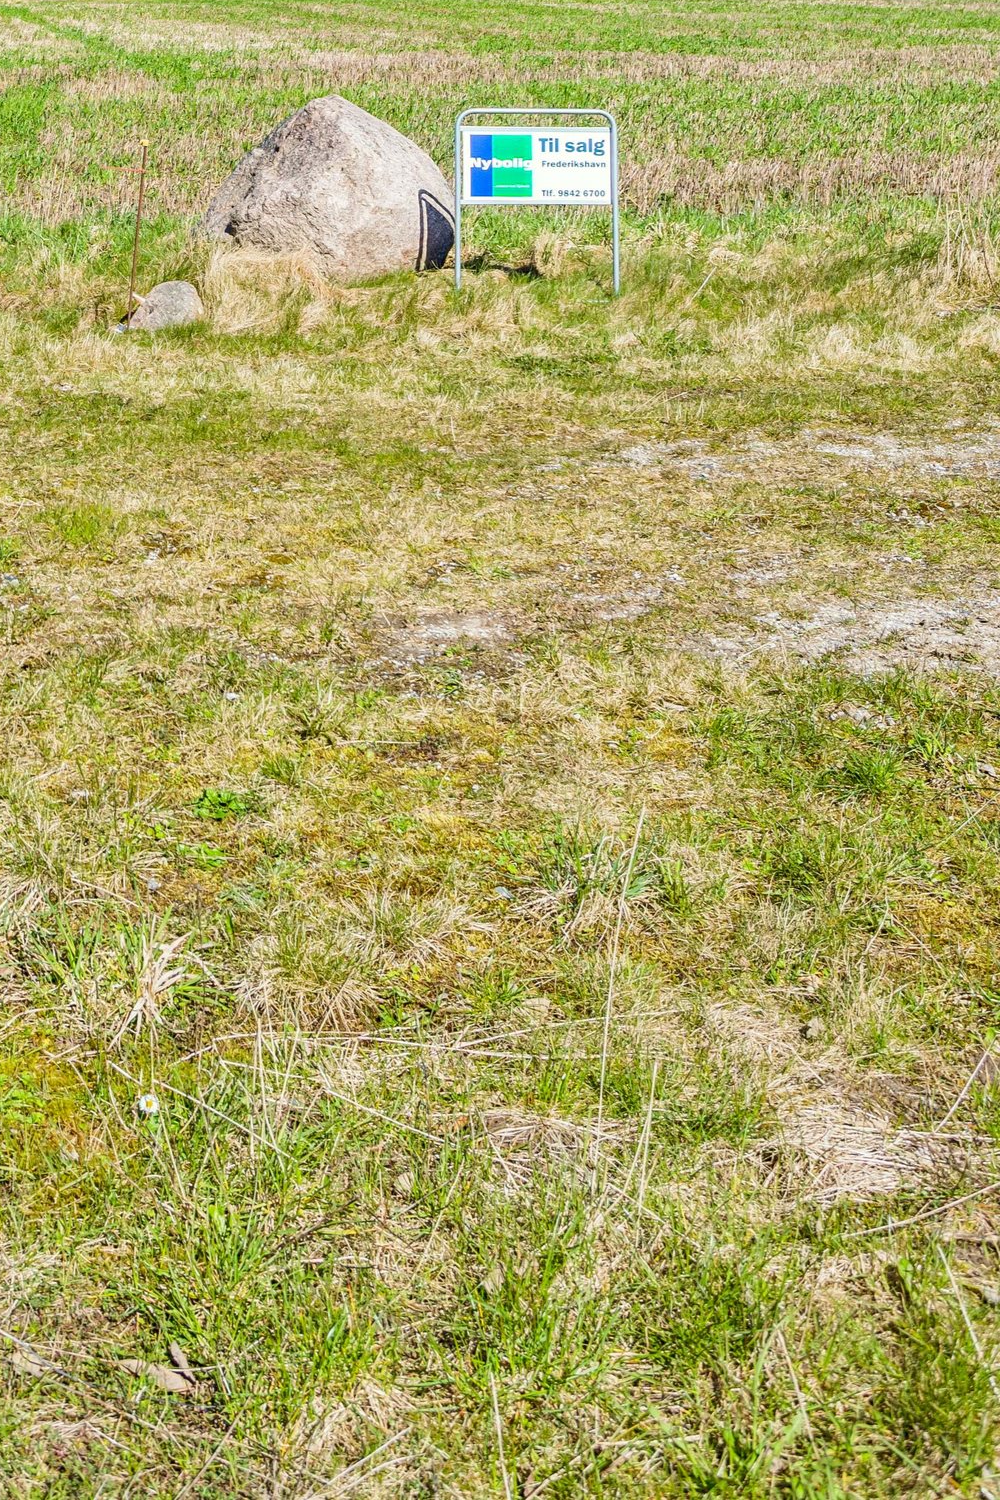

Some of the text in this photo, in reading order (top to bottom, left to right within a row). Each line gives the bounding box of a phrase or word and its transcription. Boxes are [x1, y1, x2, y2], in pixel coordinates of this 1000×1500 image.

[538, 137, 606, 156] Til salg
[470, 157, 534, 171] Nybolig
[541, 160, 606, 168] Frederikshavn
[541, 189, 606, 197] Tlf. 9842 6700
